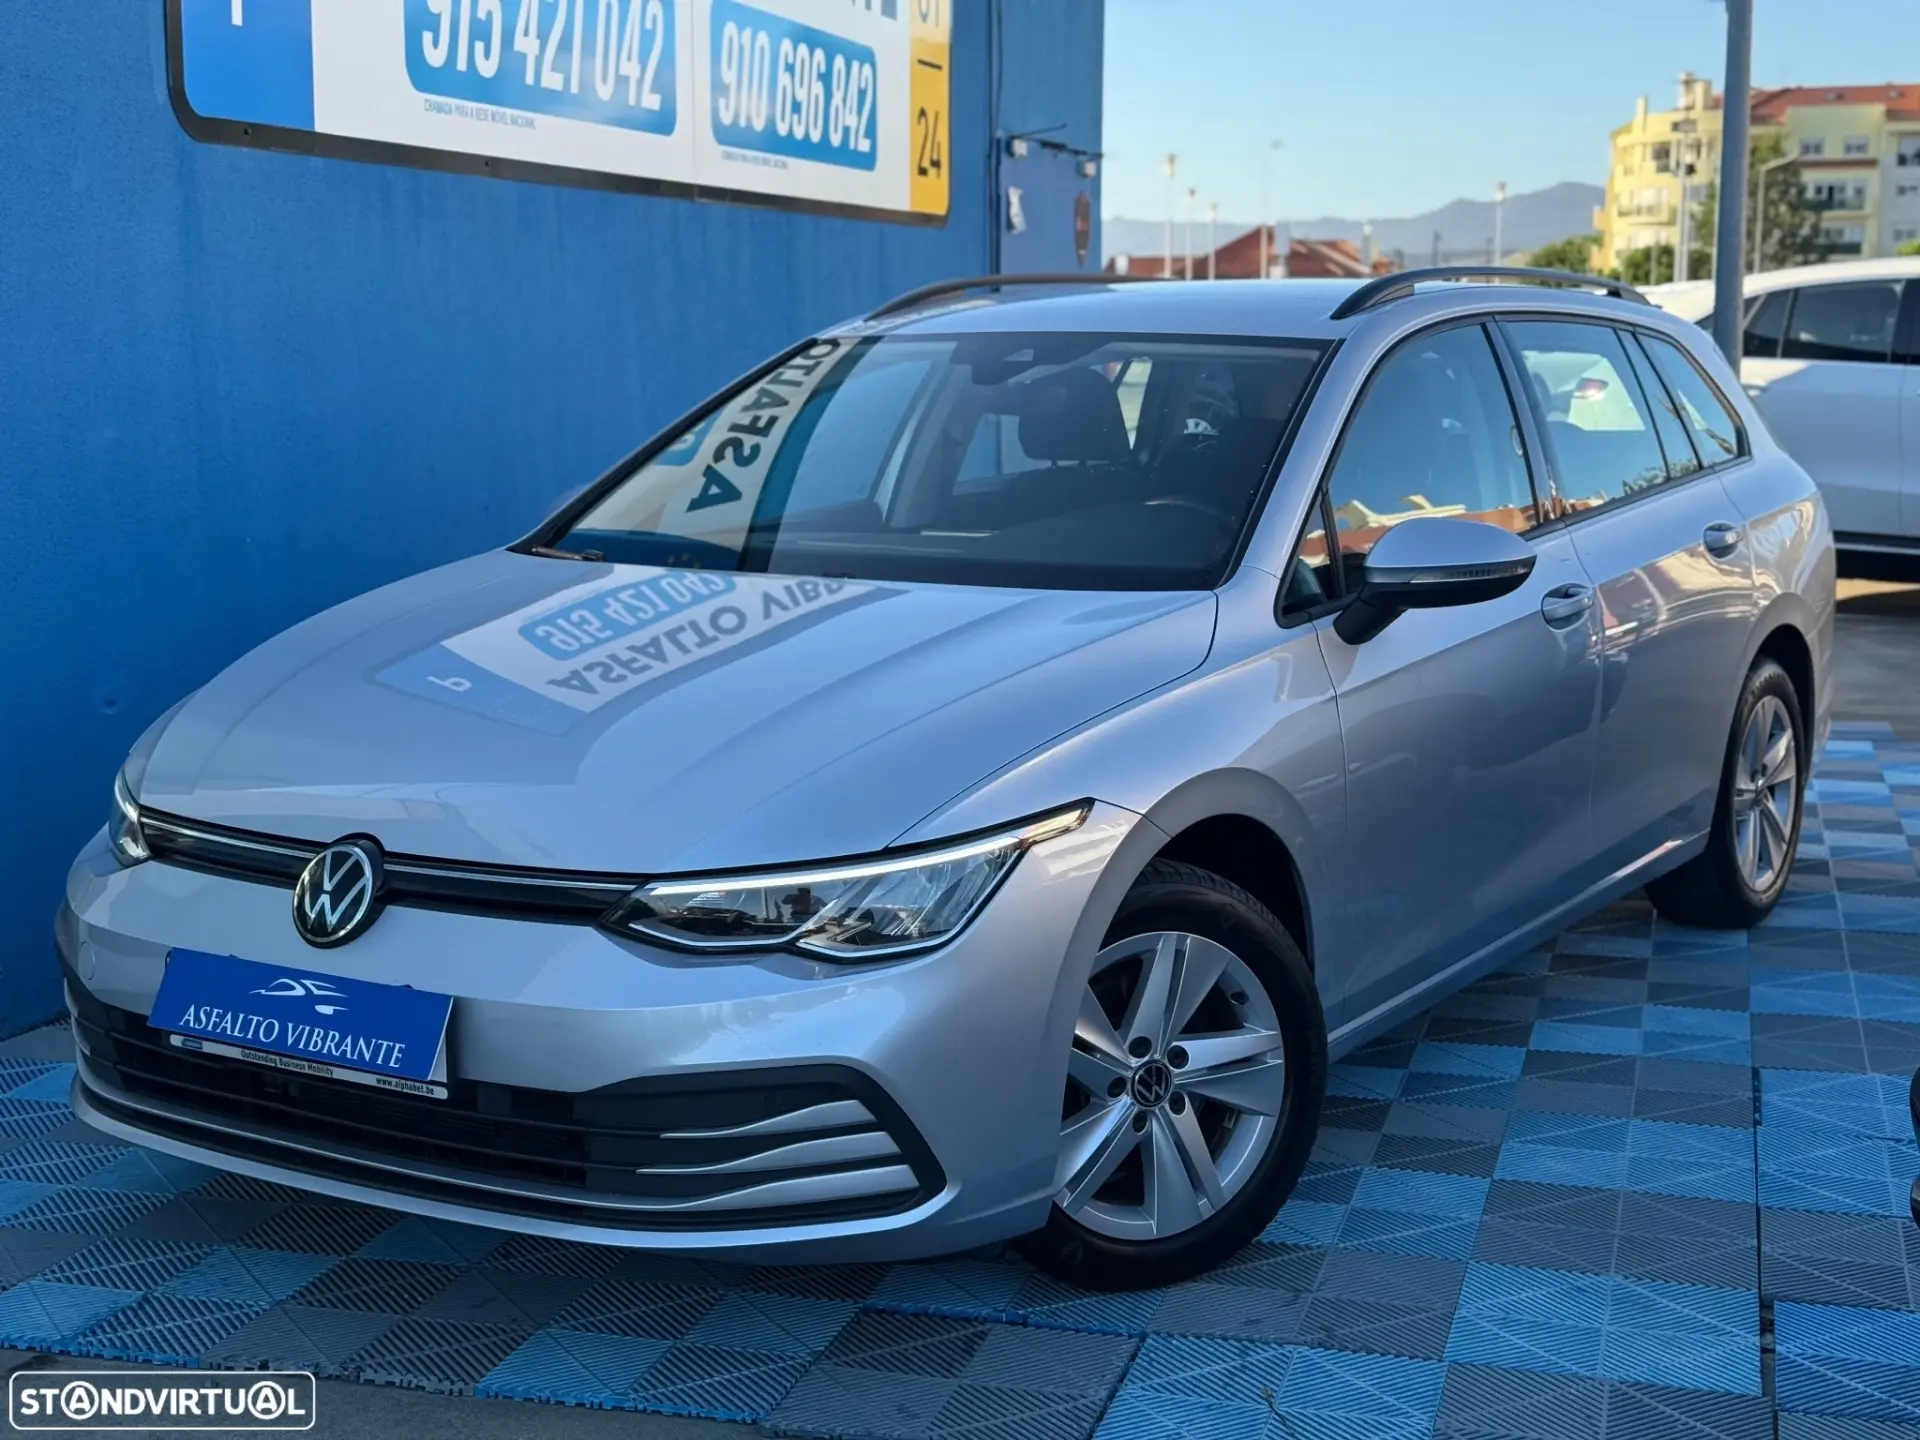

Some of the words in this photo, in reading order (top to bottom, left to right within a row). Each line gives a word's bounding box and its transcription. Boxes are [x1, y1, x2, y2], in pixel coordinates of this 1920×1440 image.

[422, 0, 502, 79] 915
[513, 0, 584, 94] 421
[595, 0, 664, 111] 042
[719, 21, 770, 132] 910
[775, 36, 827, 145] 696
[829, 48, 875, 153] 842
[423, 98, 453, 115] CHAMADA
[917, 106, 942, 178] 24
[178, 1003, 280, 1043] ASFALTO
[287, 1022, 405, 1068] VIBRANTE
[241, 1049, 277, 1067] Outstanding
[279, 1057, 306, 1071] Business
[307, 1063, 334, 1078] Mobility
[375, 1077, 435, 1096] www.alphabet.be
